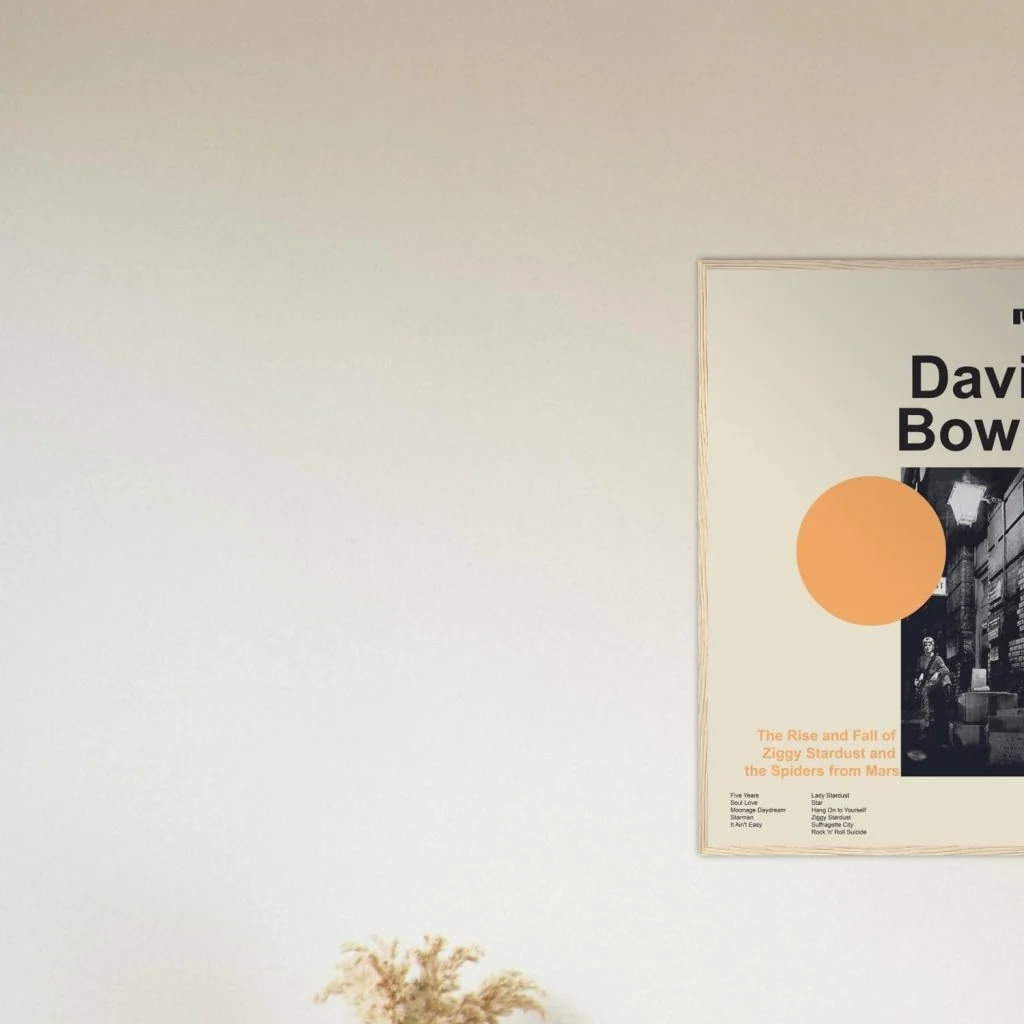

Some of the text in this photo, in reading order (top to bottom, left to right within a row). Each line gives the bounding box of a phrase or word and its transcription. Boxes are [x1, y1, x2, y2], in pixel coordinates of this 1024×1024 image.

[757, 729, 896, 741] The Rise and Fall of
[763, 747, 895, 762] Ziggy Stardust and
[745, 765, 899, 779] the Spiders from Mars
[811, 792, 825, 800] Lady
[811, 814, 826, 822] Ziggy
[811, 821, 854, 829] Suffragette City
